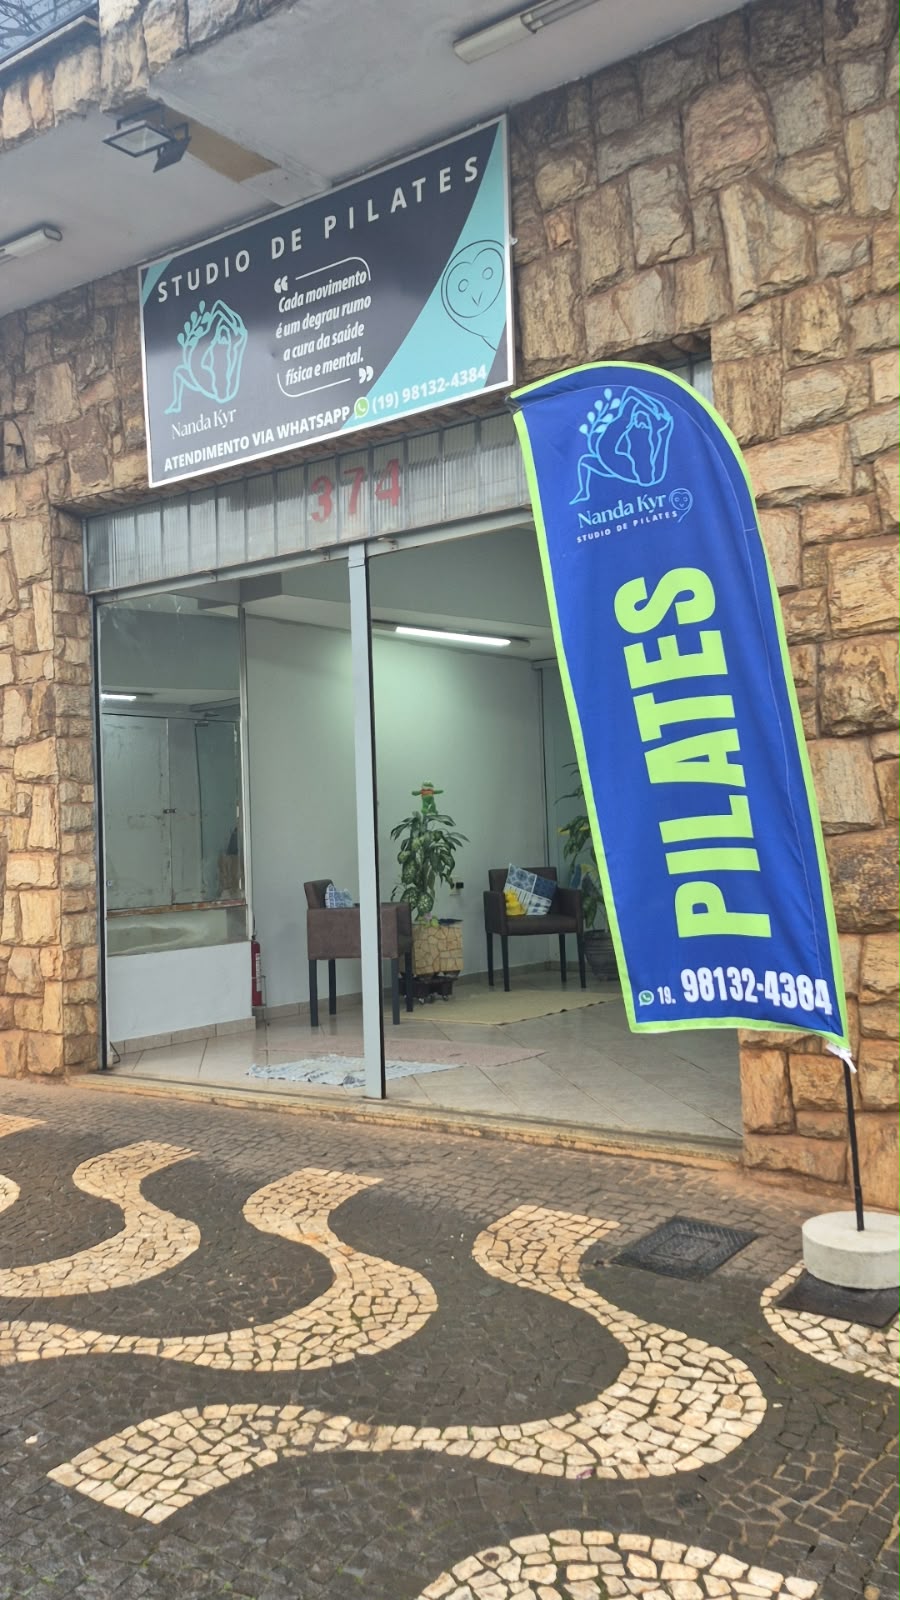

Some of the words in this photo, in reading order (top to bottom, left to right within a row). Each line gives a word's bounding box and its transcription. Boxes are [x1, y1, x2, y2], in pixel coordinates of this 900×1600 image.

[158, 250, 250, 303] STUDIO
[271, 228, 302, 260] DE
[324, 156, 478, 239] PILATES
[278, 292, 304, 313] Cada
[305, 270, 367, 304] movimento
[275, 322, 283, 339] é
[283, 320, 301, 337] um
[302, 306, 340, 331] degrau
[341, 295, 372, 317] rumo
[283, 348, 291, 362] a
[292, 340, 315, 358] cura
[316, 333, 331, 349] da
[331, 321, 365, 345] saúde
[285, 366, 313, 386] física
[314, 364, 321, 377] e
[322, 346, 364, 374] mental.
[372, 391, 399, 414] (19)
[402, 364, 487, 402] 98132-4384
[164, 436, 250, 472] ATENDIMENTO
[252, 430, 275, 446] VIA
[276, 406, 350, 440] WHATSAPP
[171, 413, 212, 440] Nanda
[213, 408, 237, 429] Kyr
[311, 458, 401, 523] 374
[577, 499, 635, 529] Nanda
[637, 493, 667, 513] Kyr
[576, 528, 611, 543] STUDIO
[616, 522, 628, 532] DE
[633, 510, 678, 527] PILATES
[613, 567, 772, 938] PILATES
[657, 986, 676, 1005] 19.
[680, 966, 833, 1015] 98132-4384
